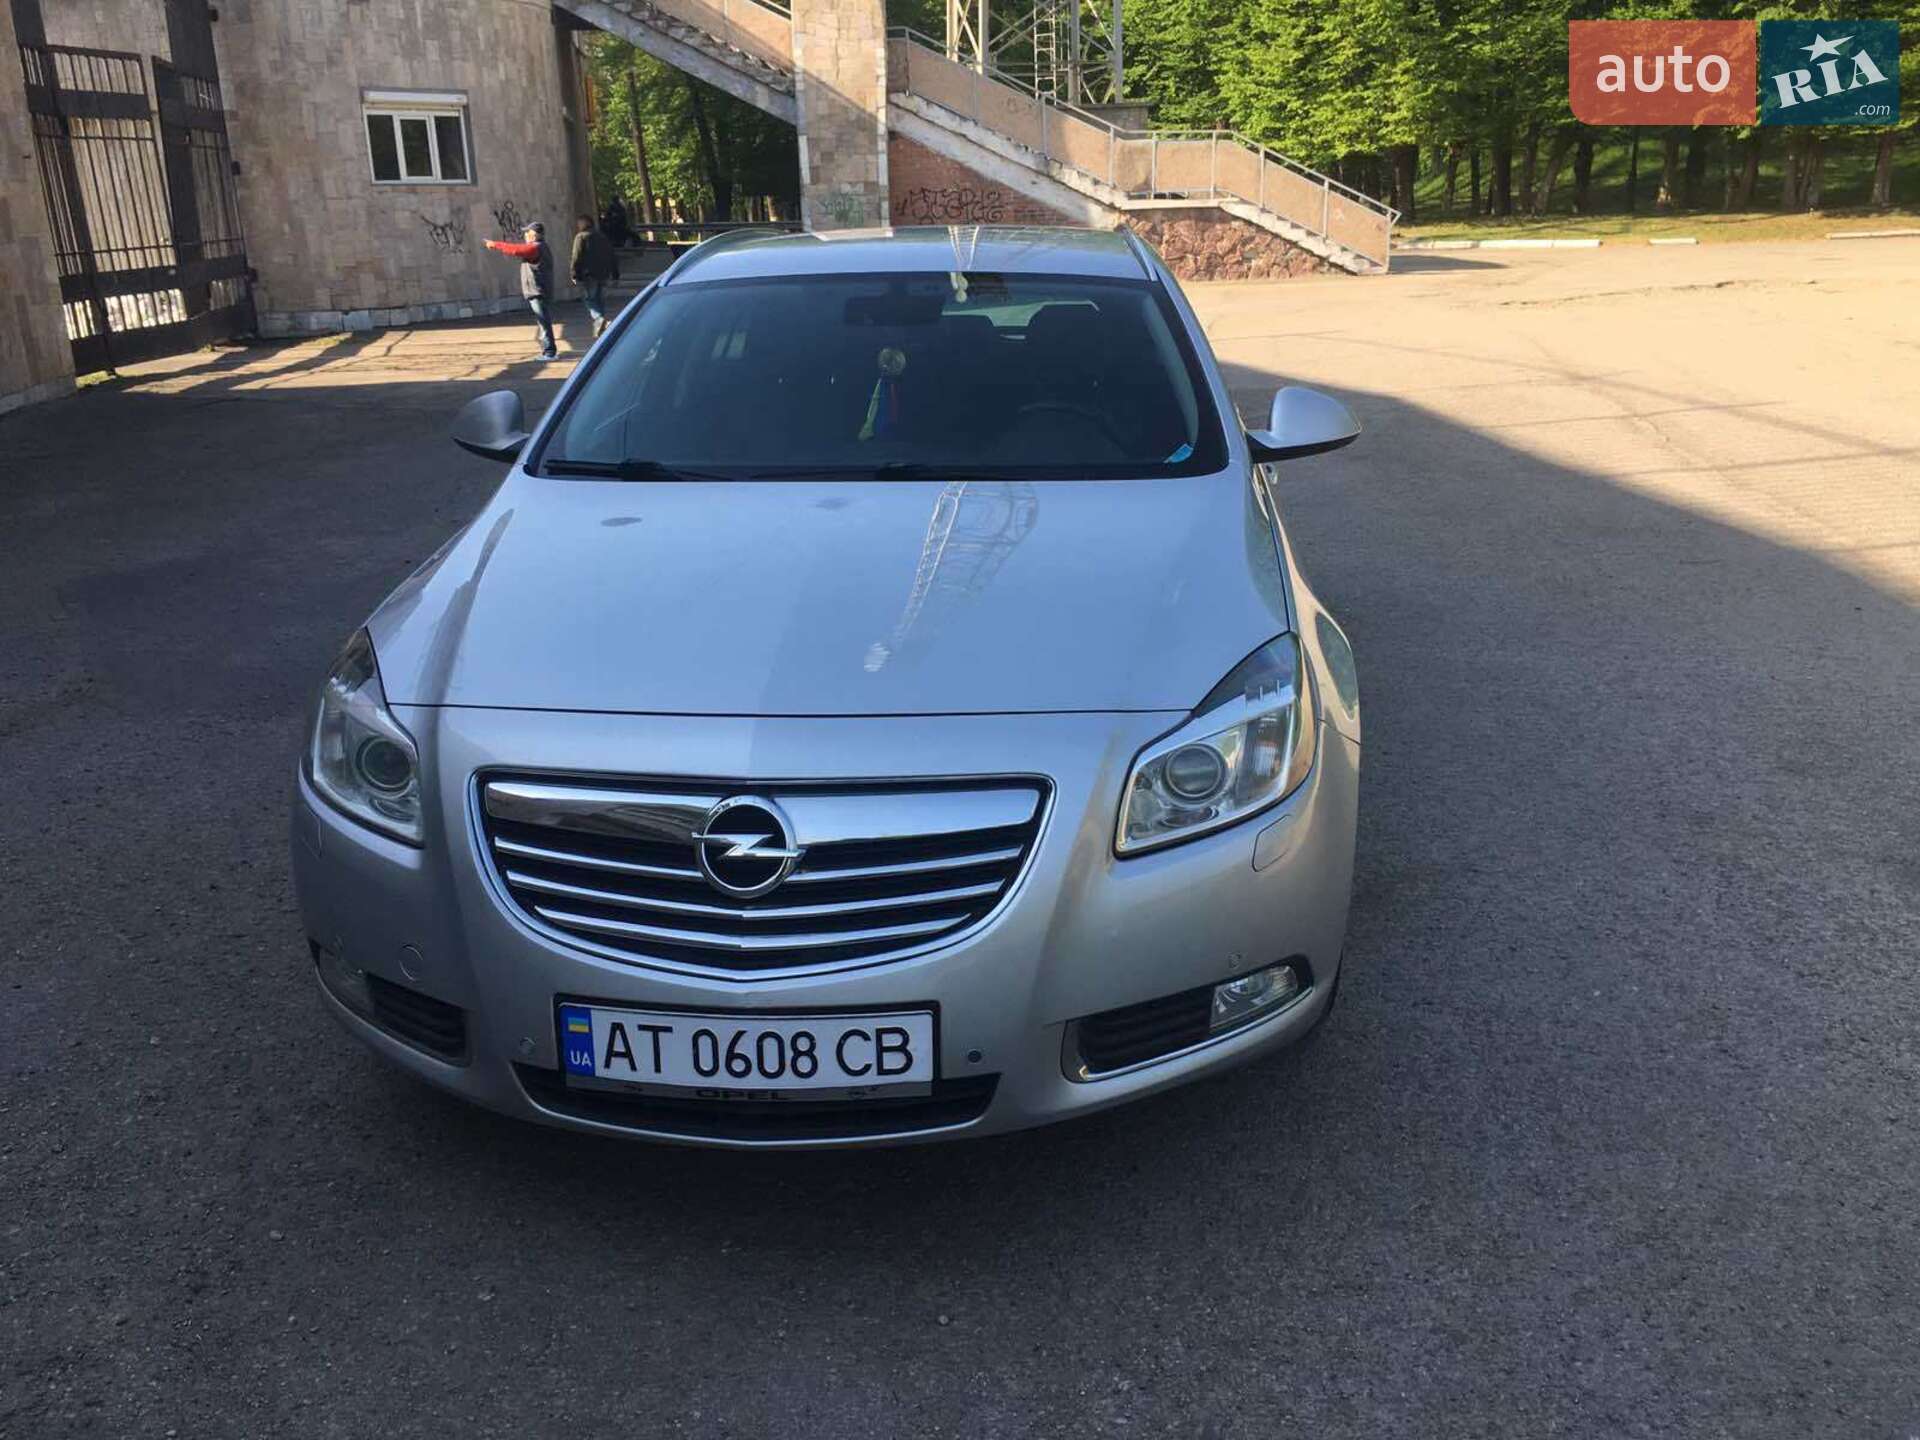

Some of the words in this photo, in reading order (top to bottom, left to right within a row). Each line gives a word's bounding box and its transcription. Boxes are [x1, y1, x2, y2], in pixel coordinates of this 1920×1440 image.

[570, 1050, 592, 1068] UA
[603, 1022, 673, 1074] AT
[691, 1028, 819, 1080] 0608
[835, 1026, 914, 1077] CB
